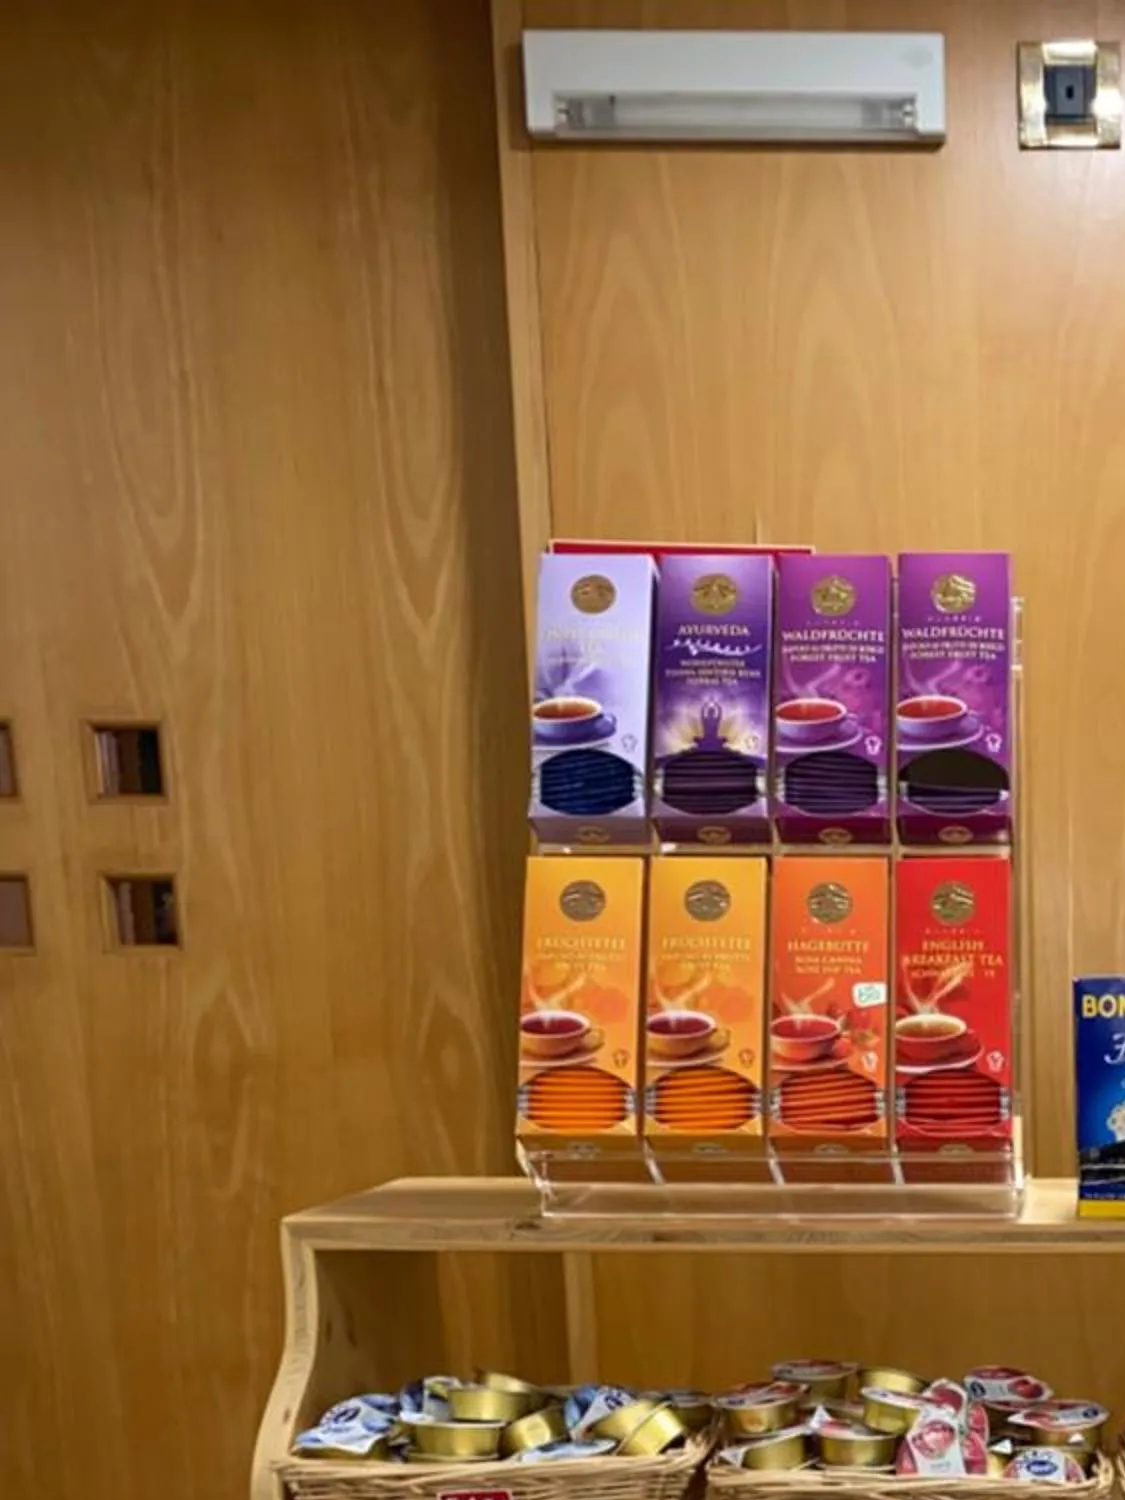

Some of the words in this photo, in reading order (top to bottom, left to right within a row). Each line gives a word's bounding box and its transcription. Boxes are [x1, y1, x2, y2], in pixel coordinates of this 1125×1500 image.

[678, 625, 749, 636] AYURVEDA
[782, 629, 884, 642] WALDFRÜCHTE
[901, 626, 1004, 640] WALDFRÜCHTE
[922, 941, 984, 951] ENGLISH
